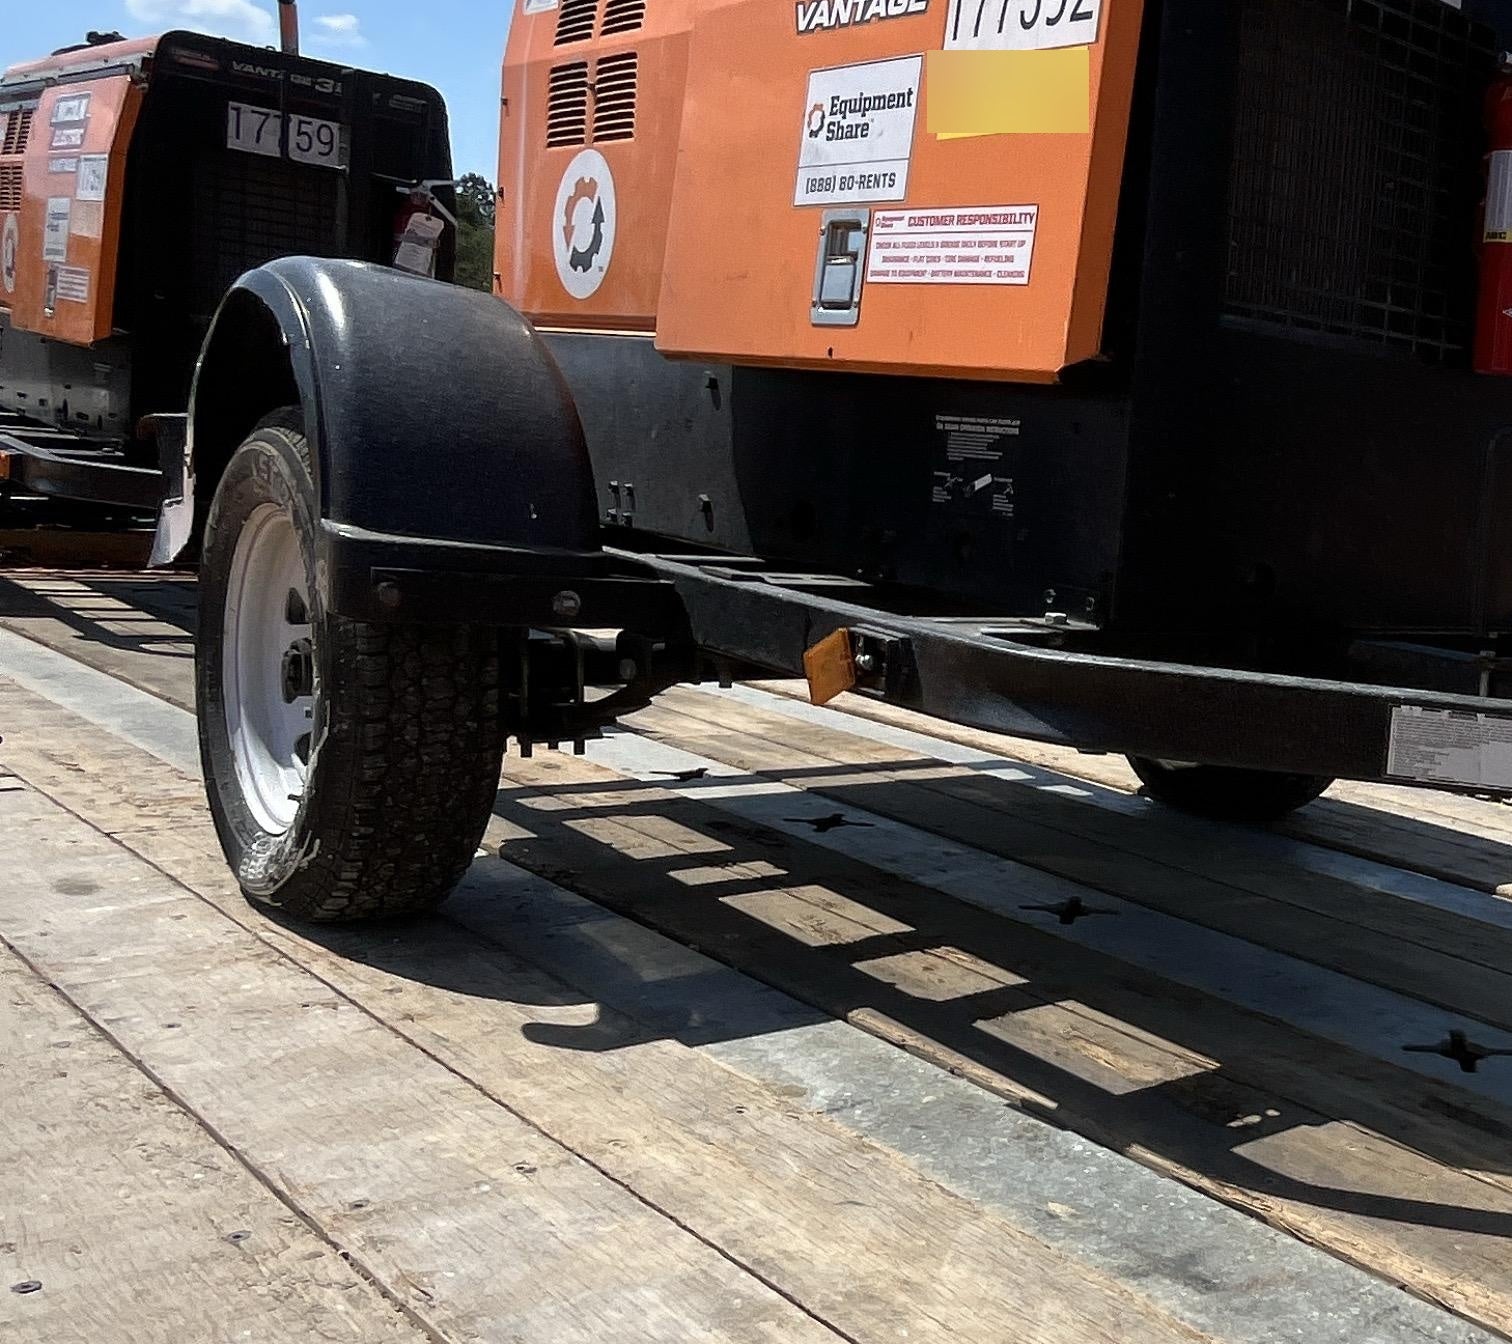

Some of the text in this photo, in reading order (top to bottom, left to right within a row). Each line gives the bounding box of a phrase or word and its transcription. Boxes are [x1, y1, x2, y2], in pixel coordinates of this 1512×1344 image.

[829, 87, 914, 119] Equipment
[826, 120, 870, 142] Share
[805, 172, 897, 195] (888) 80-RENTS
[908, 214, 955, 228] CUSTOMER
[956, 211, 1035, 226] RESPONSIBILITY
